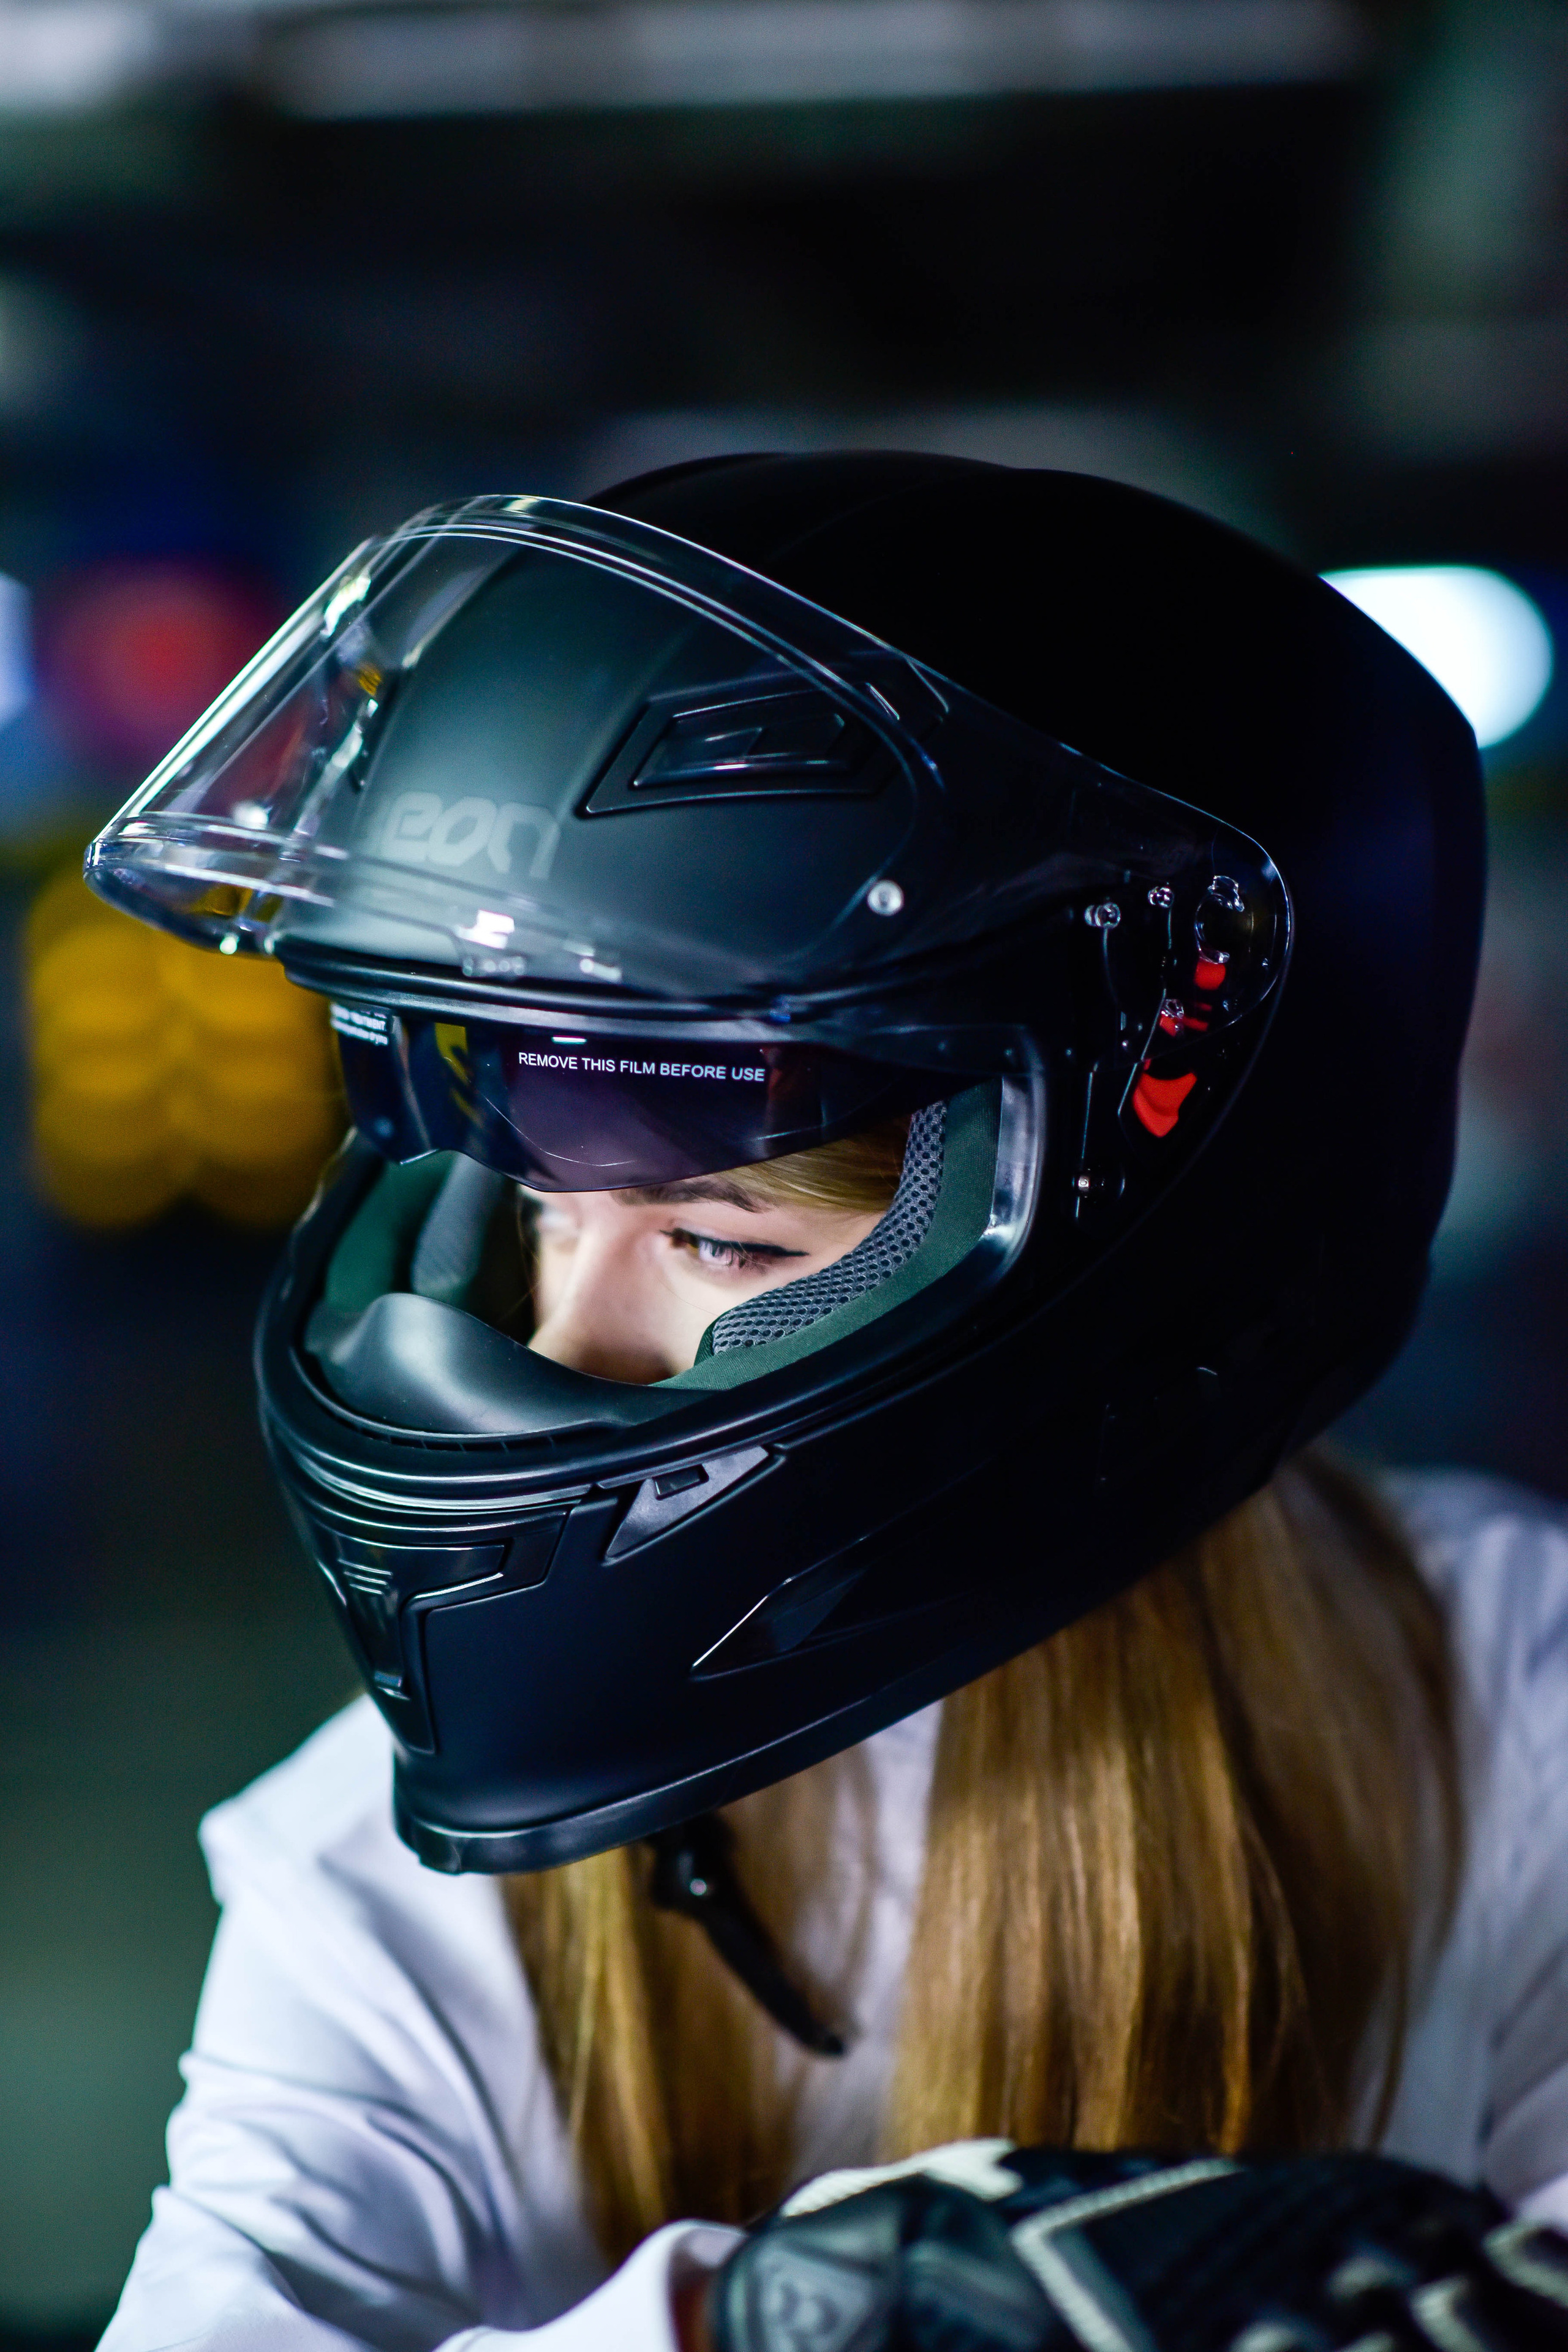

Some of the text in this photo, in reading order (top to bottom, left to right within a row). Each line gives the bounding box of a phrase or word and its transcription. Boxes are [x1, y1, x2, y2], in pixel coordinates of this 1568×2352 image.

[519, 1052, 766, 1082] REMOVE THIS FILM BEFORE USE
